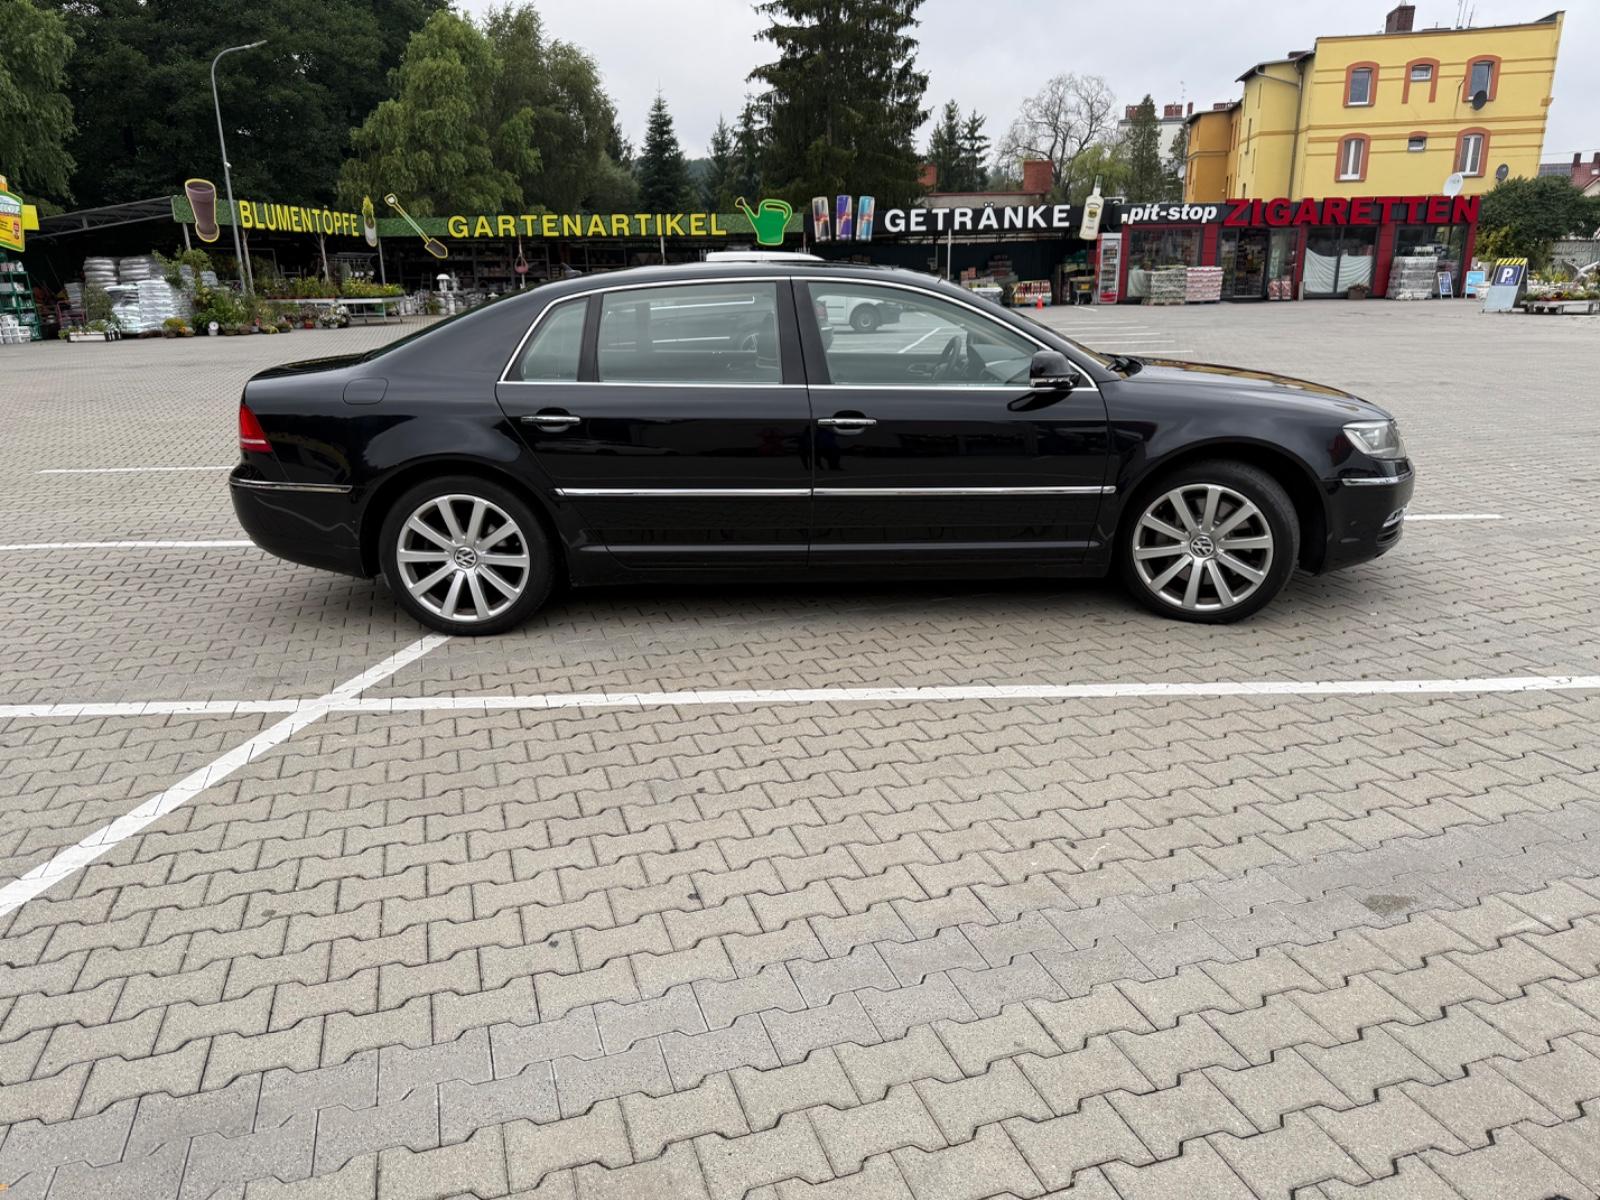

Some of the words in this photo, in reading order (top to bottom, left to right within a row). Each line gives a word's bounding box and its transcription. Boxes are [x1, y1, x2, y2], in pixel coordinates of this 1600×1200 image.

[239, 200, 359, 237] BLUMENTÖPFE
[448, 213, 727, 238] GARTENARTIKEL
[885, 203, 1071, 233] GETRÄNKE
[1223, 196, 1480, 227] ZIGARETTEN
[1500, 267, 1514, 283] P
